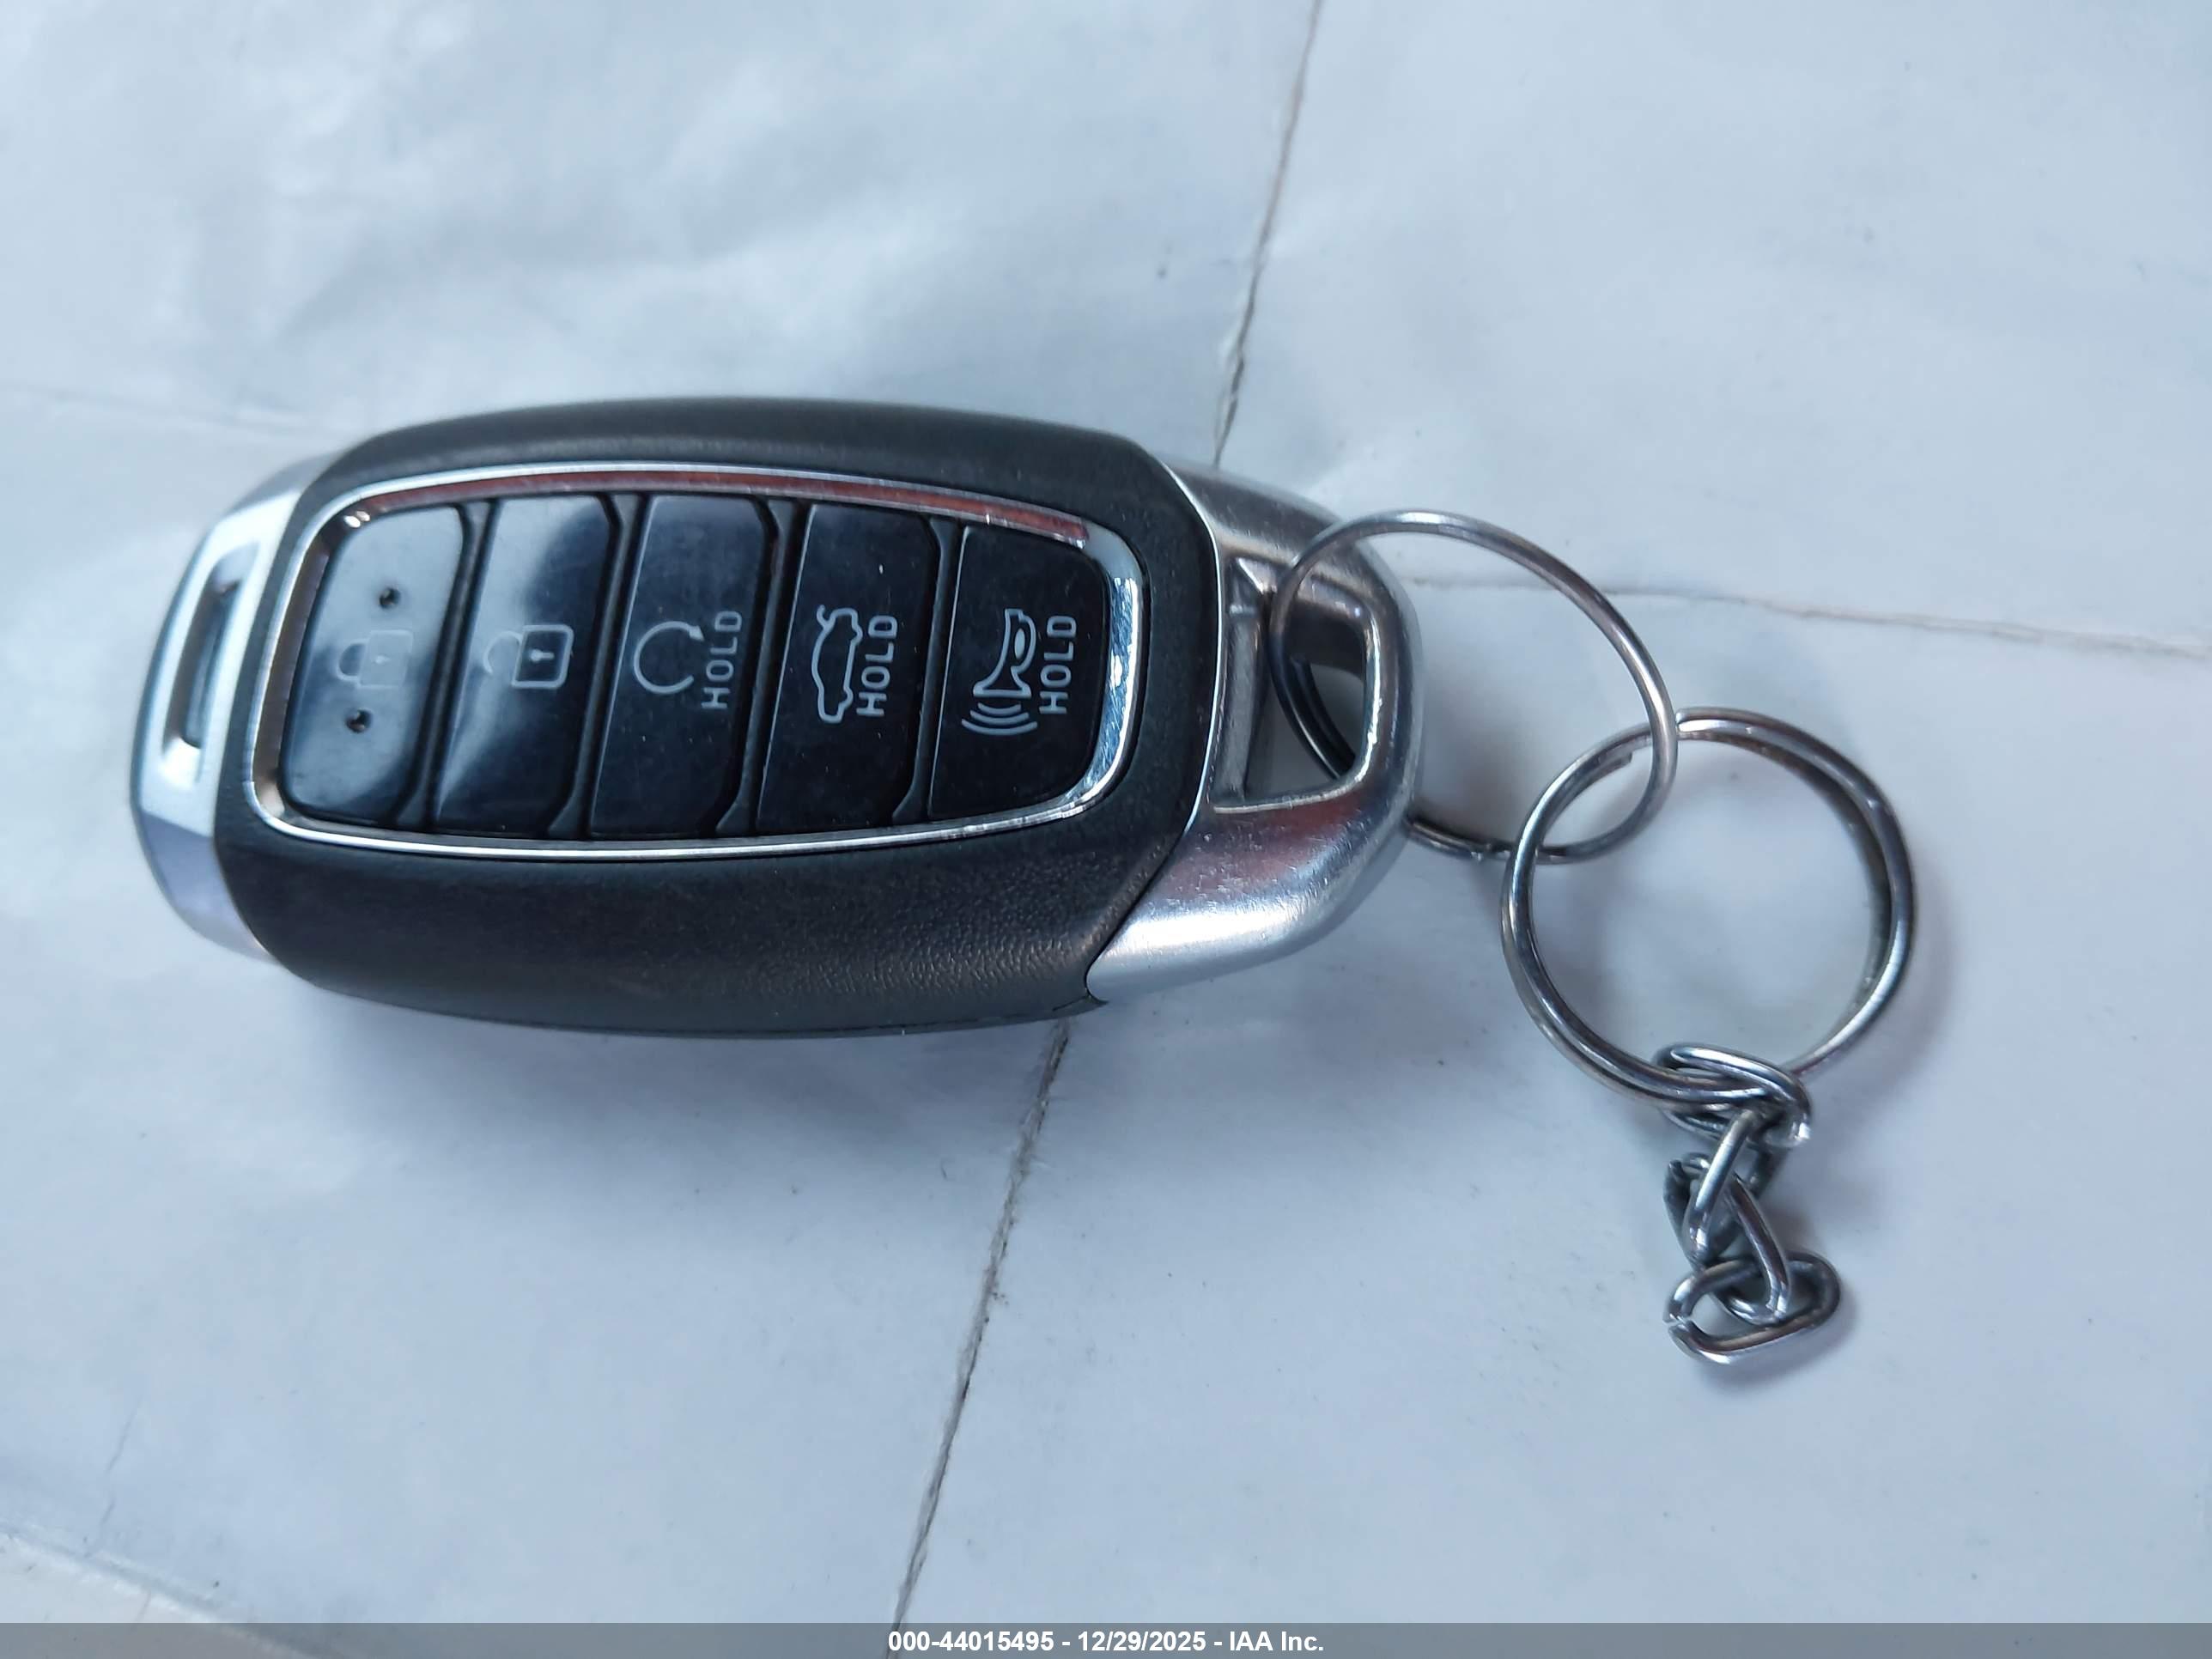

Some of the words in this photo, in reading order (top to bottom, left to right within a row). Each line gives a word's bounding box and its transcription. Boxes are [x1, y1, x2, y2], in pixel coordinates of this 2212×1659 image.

[701, 610, 743, 710] HOLD
[856, 614, 898, 717] HOLD
[1038, 614, 1078, 715] HOLD
